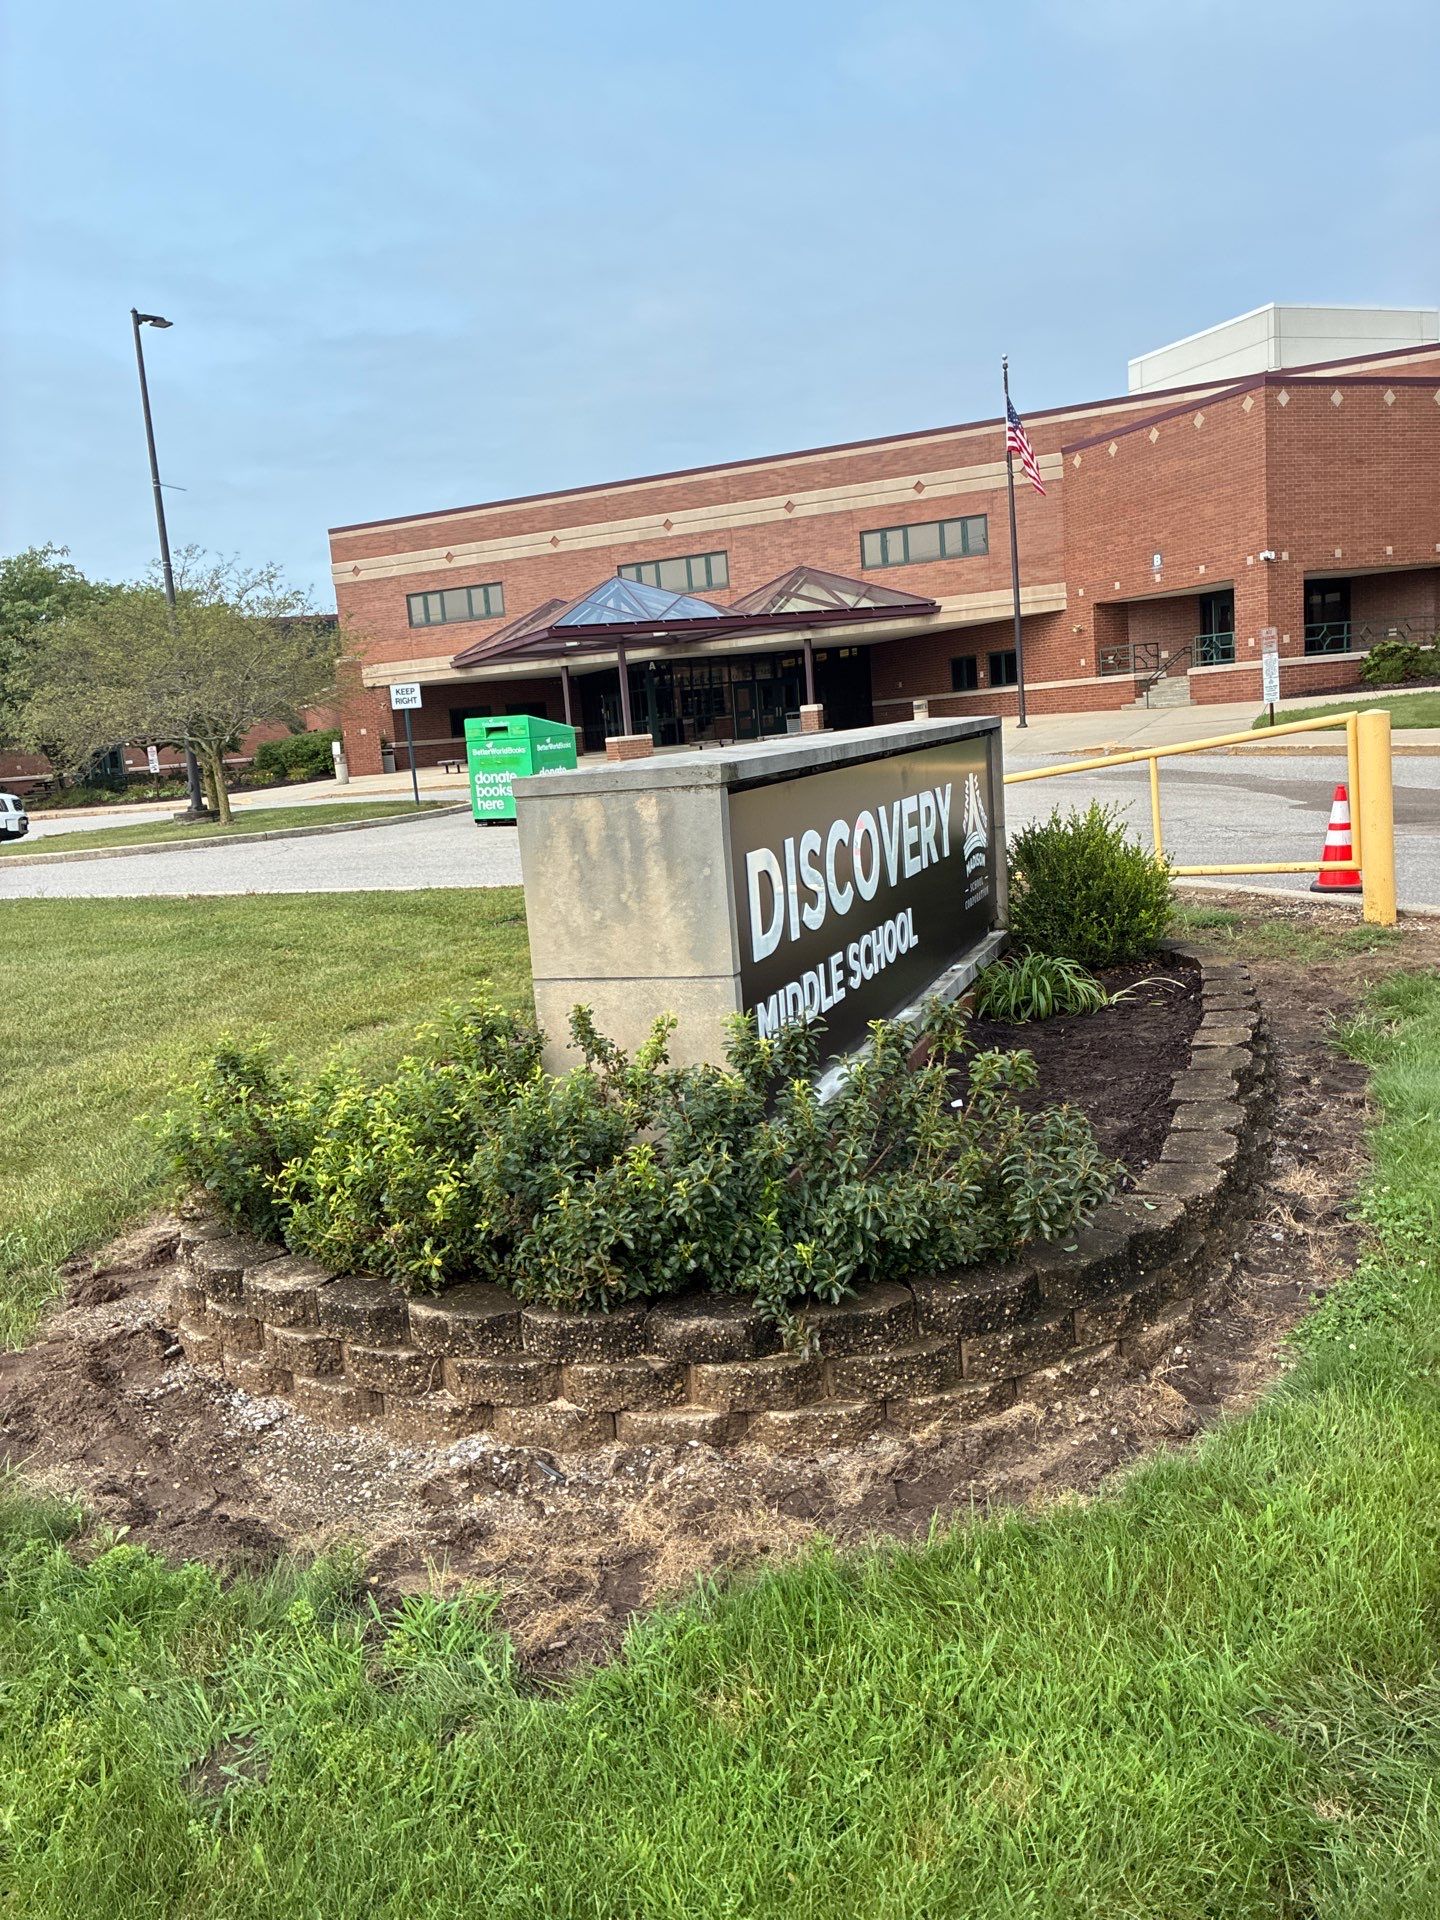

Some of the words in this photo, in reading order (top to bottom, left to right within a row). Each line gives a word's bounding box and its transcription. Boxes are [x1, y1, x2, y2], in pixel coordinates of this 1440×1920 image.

[649, 661, 656, 671] A
[395, 688, 415, 696] KEEP
[395, 697, 417, 705] RIGHT
[472, 746, 526, 756] BetterWorldBooks
[476, 784, 512, 797] books
[477, 798, 505, 810] here
[746, 783, 952, 963] DISCOVERY
[756, 951, 846, 1048] MIDDLE
[848, 907, 919, 990] SCHOOL
